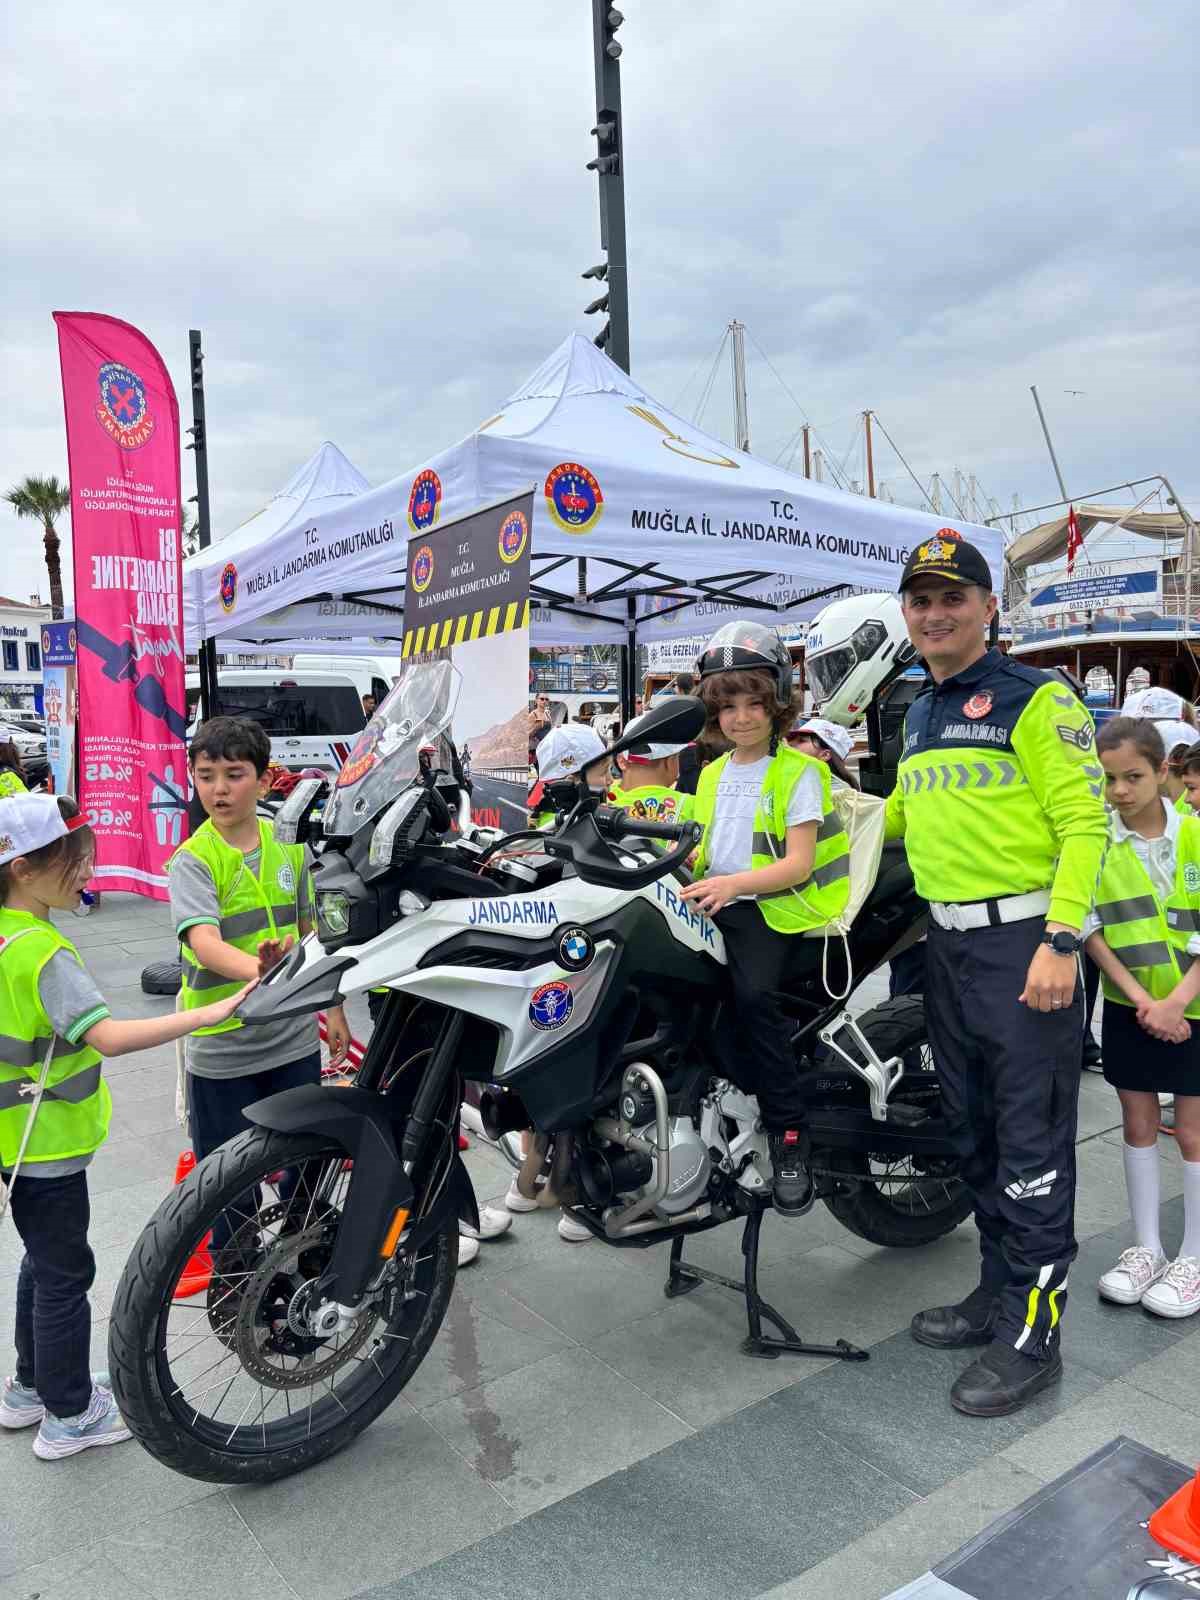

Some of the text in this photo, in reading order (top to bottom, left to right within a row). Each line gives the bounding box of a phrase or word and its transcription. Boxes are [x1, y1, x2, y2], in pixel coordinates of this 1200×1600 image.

[770, 500, 798, 521] T.C.
[304, 527, 319, 546] T.C.
[631, 508, 697, 535] MUĞLA
[702, 513, 717, 536] İL
[720, 520, 812, 549] JANDARMA
[816, 534, 912, 565] KOMUTANLIĞ
[246, 572, 273, 596] MUĞLA
[273, 567, 281, 585] İL
[281, 547, 327, 580] JANDARMA
[328, 520, 394, 560] KOMUTANLIĞI
[450, 560, 475, 577] MUĞLA
[424, 588, 459, 608] JANDARMA
[459, 569, 510, 596] KOMUTANLIĞI
[469, 900, 559, 925] JANDARMA
